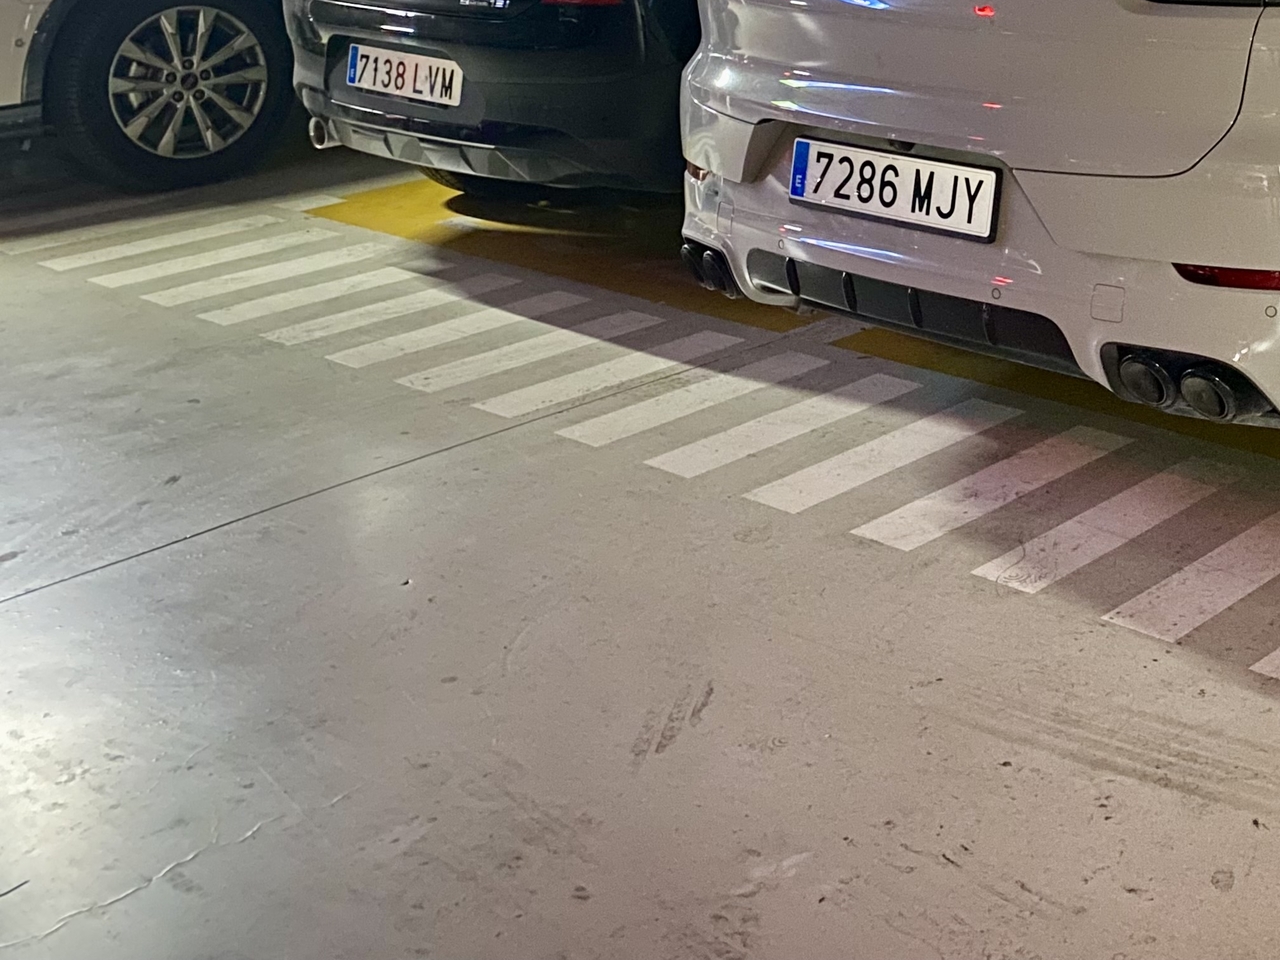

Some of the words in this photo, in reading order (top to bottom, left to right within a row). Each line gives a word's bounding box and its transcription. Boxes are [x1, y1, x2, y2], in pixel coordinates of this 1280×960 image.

[357, 53, 407, 91] 7138
[412, 62, 455, 100] LVM
[795, 175, 802, 187] E
[812, 151, 900, 208] 7286
[910, 168, 984, 224] MJY
